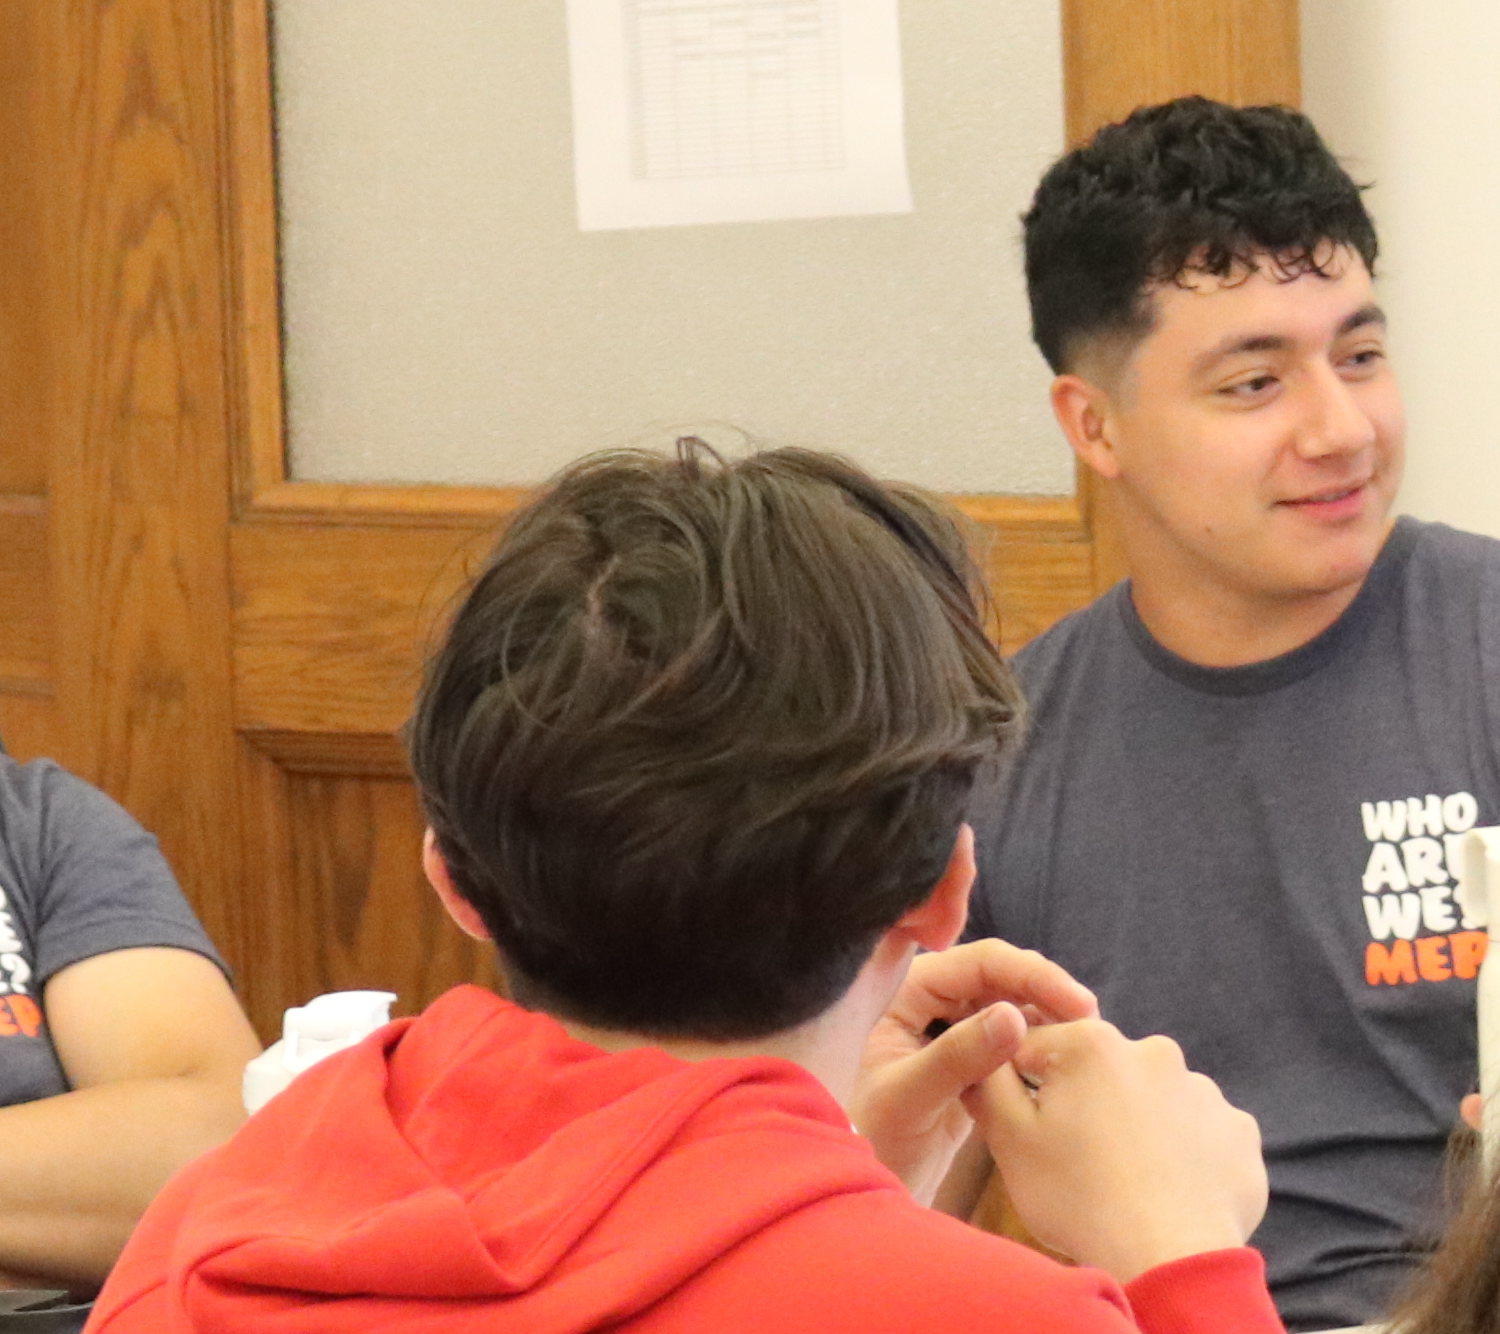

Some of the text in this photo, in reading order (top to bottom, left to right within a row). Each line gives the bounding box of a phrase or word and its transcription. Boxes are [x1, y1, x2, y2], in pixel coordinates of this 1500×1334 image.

[1361, 791, 1478, 841] WHO
[1362, 885, 1481, 940] WE
[1365, 931, 1488, 986] MEP
